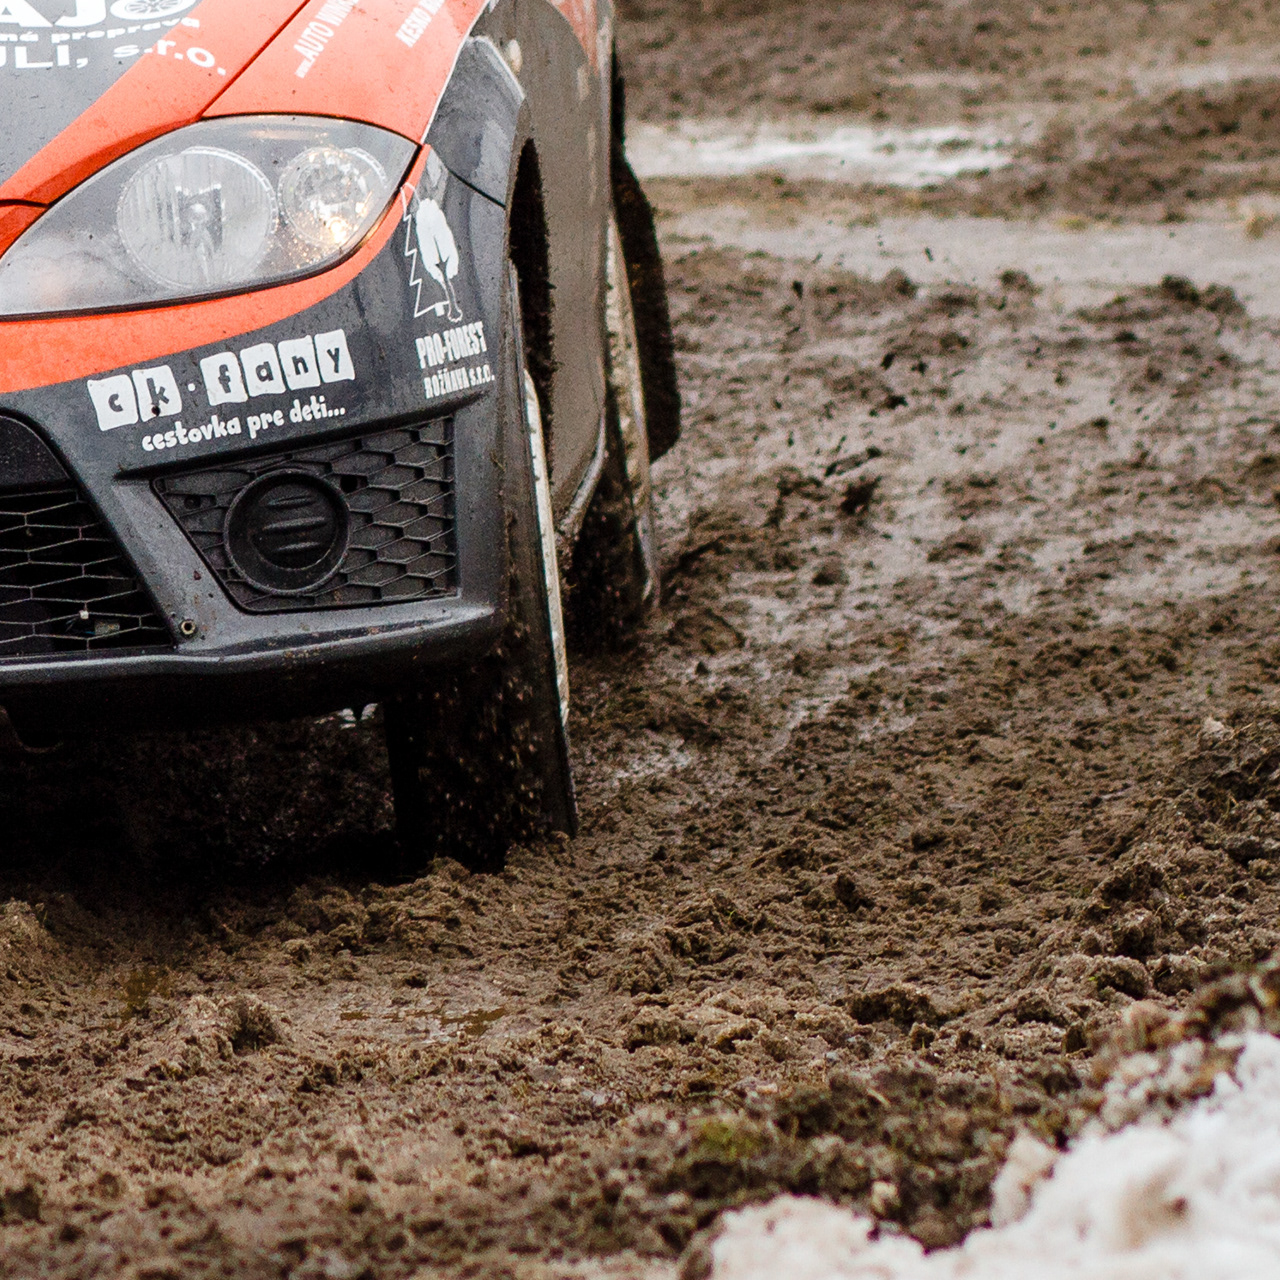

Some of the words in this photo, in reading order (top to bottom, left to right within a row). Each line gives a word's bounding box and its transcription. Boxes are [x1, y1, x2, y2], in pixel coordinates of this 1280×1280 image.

[50, 16, 201, 44] preprava
[113, 38, 227, 76] s.r.o.
[415, 320, 488, 370] PRO-FOREST
[141, 414, 242, 451] cestovka
[246, 408, 285, 440] pre
[289, 395, 346, 424] deti...
